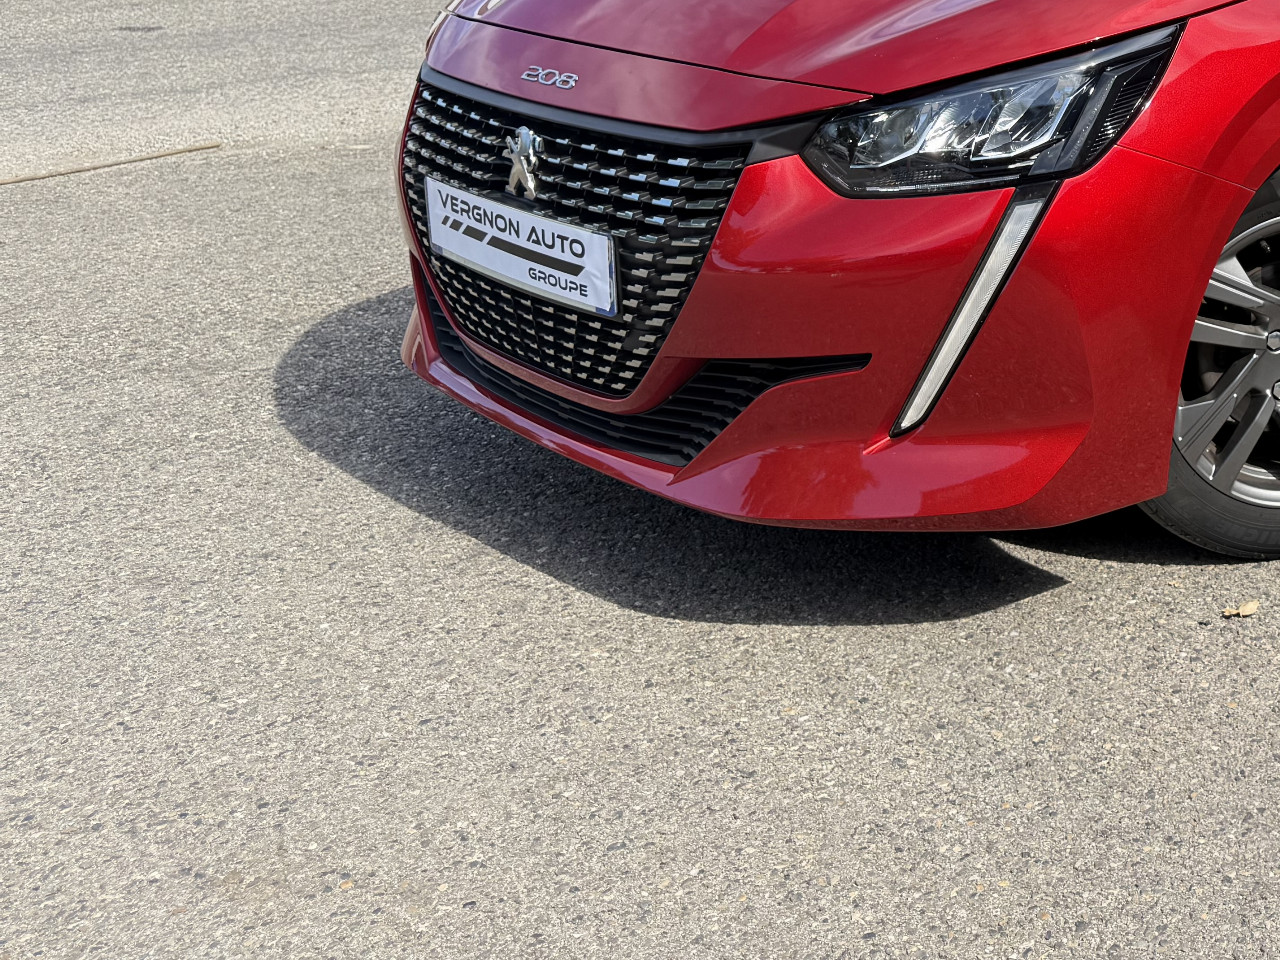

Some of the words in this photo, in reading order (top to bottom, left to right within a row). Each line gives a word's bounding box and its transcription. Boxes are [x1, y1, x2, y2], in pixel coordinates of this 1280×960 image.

[520, 65, 579, 90] 208
[438, 189, 520, 239] VERGNON
[526, 226, 586, 259] AUTO
[528, 267, 588, 297] GROUPE
